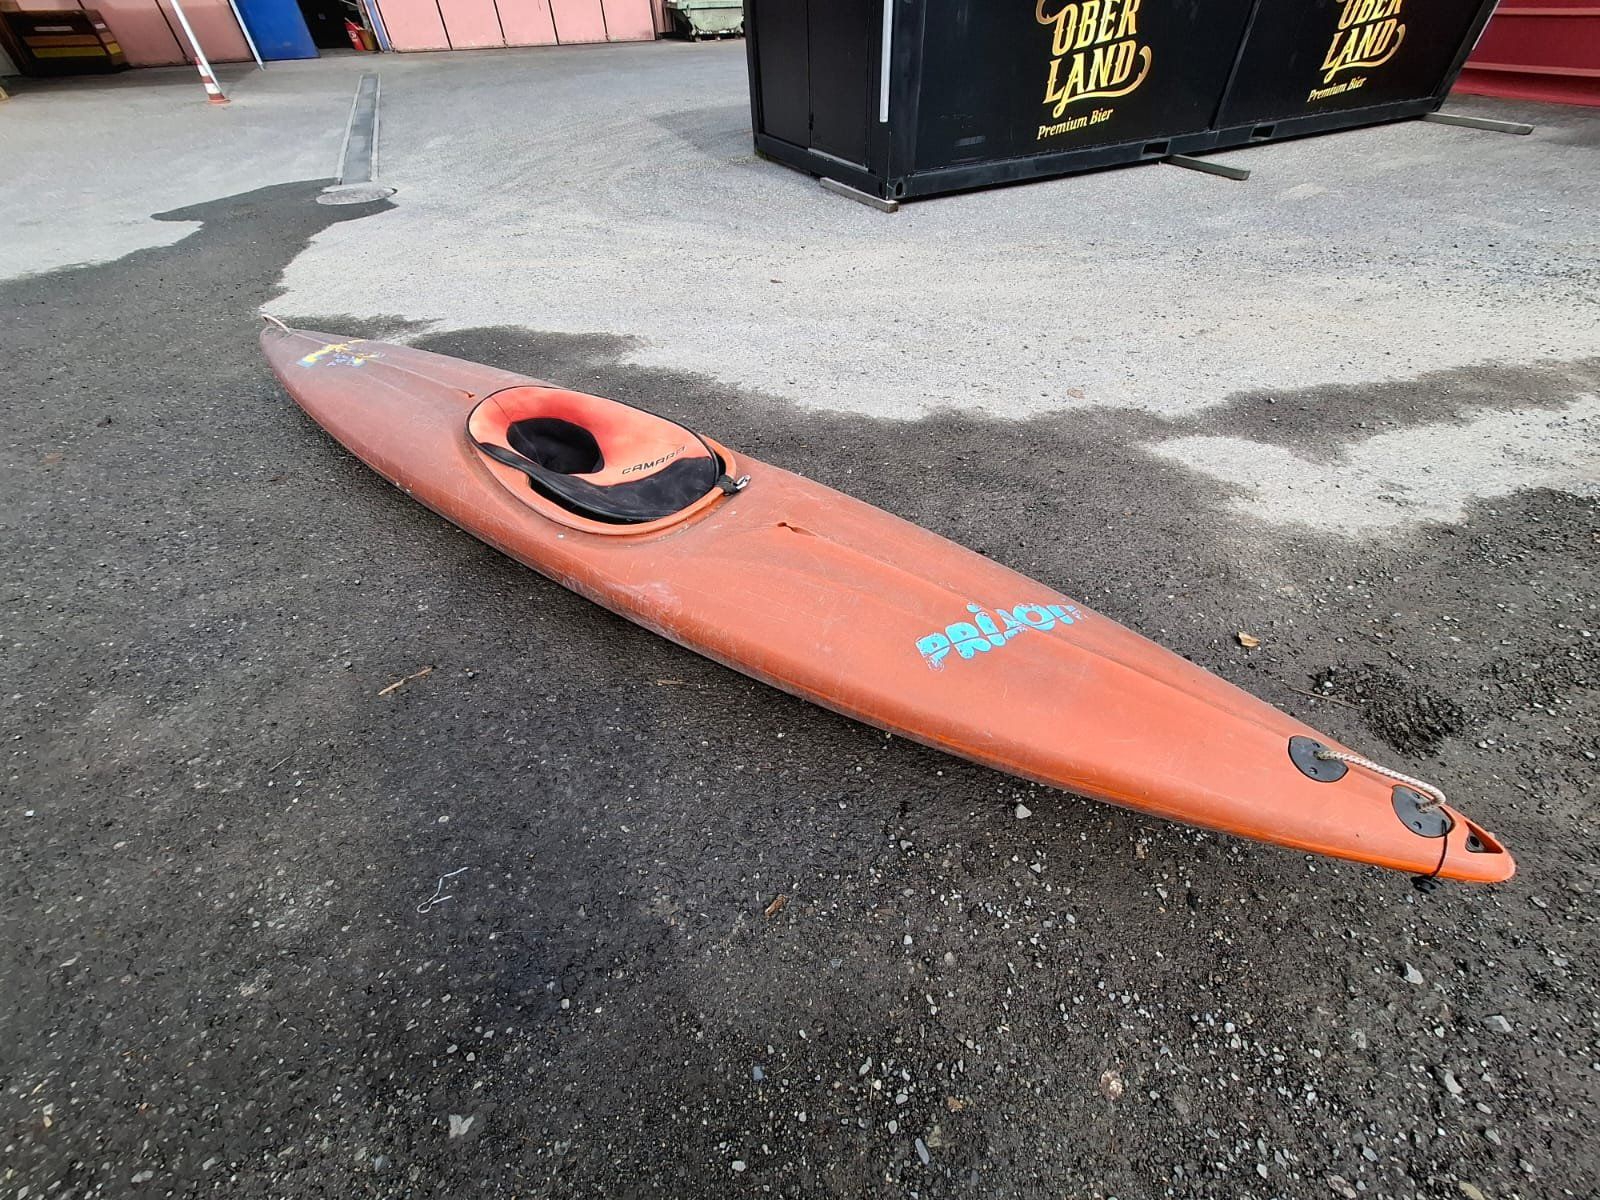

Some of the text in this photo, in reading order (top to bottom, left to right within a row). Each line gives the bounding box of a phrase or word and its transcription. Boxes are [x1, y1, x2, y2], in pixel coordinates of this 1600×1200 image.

[1036, 0, 1140, 56] OBER
[1320, 18, 1406, 84] LAND
[1042, 40, 1152, 118] LAND
[1306, 76, 1367, 102] Premium Bier
[1036, 107, 1113, 140] Premium Bier
